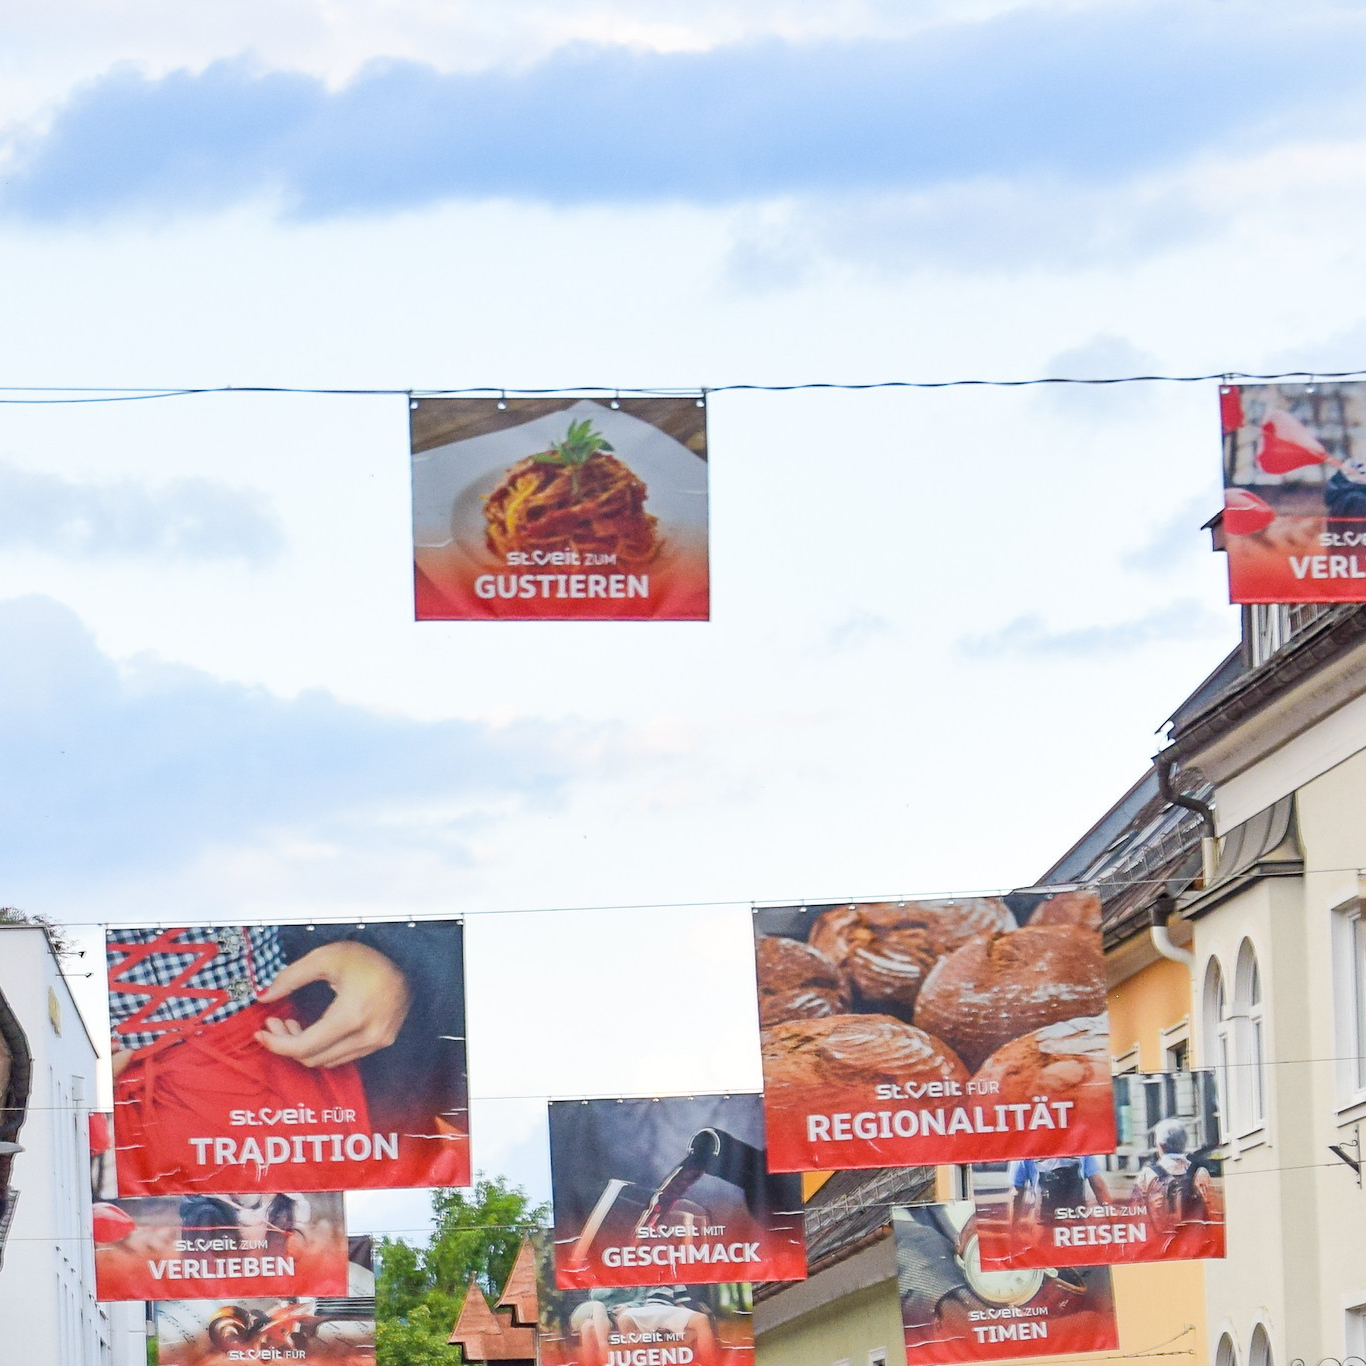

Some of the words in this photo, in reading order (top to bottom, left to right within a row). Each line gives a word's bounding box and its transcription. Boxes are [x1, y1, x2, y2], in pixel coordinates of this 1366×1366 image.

[584, 553, 616, 566] ZUM
[474, 573, 649, 599] GUSTIEREN
[966, 1078, 999, 1096] FÜR
[322, 1106, 356, 1123] FÜR
[806, 1096, 1074, 1142] REGIONALITÄT
[188, 1132, 399, 1166] TRADITION
[1120, 1205, 1147, 1217] ZUM
[703, 1224, 726, 1236] MIT
[1054, 1223, 1147, 1248] REISEN
[240, 1239, 268, 1249] ZUM
[601, 1242, 761, 1267] GESCHMACK
[148, 1256, 295, 1280] VERLIEBEN
[1025, 1306, 1048, 1316] ZUM
[666, 1332, 685, 1341] MIT
[973, 1322, 1048, 1345] TIMEN
[285, 1348, 306, 1359] FÜR
